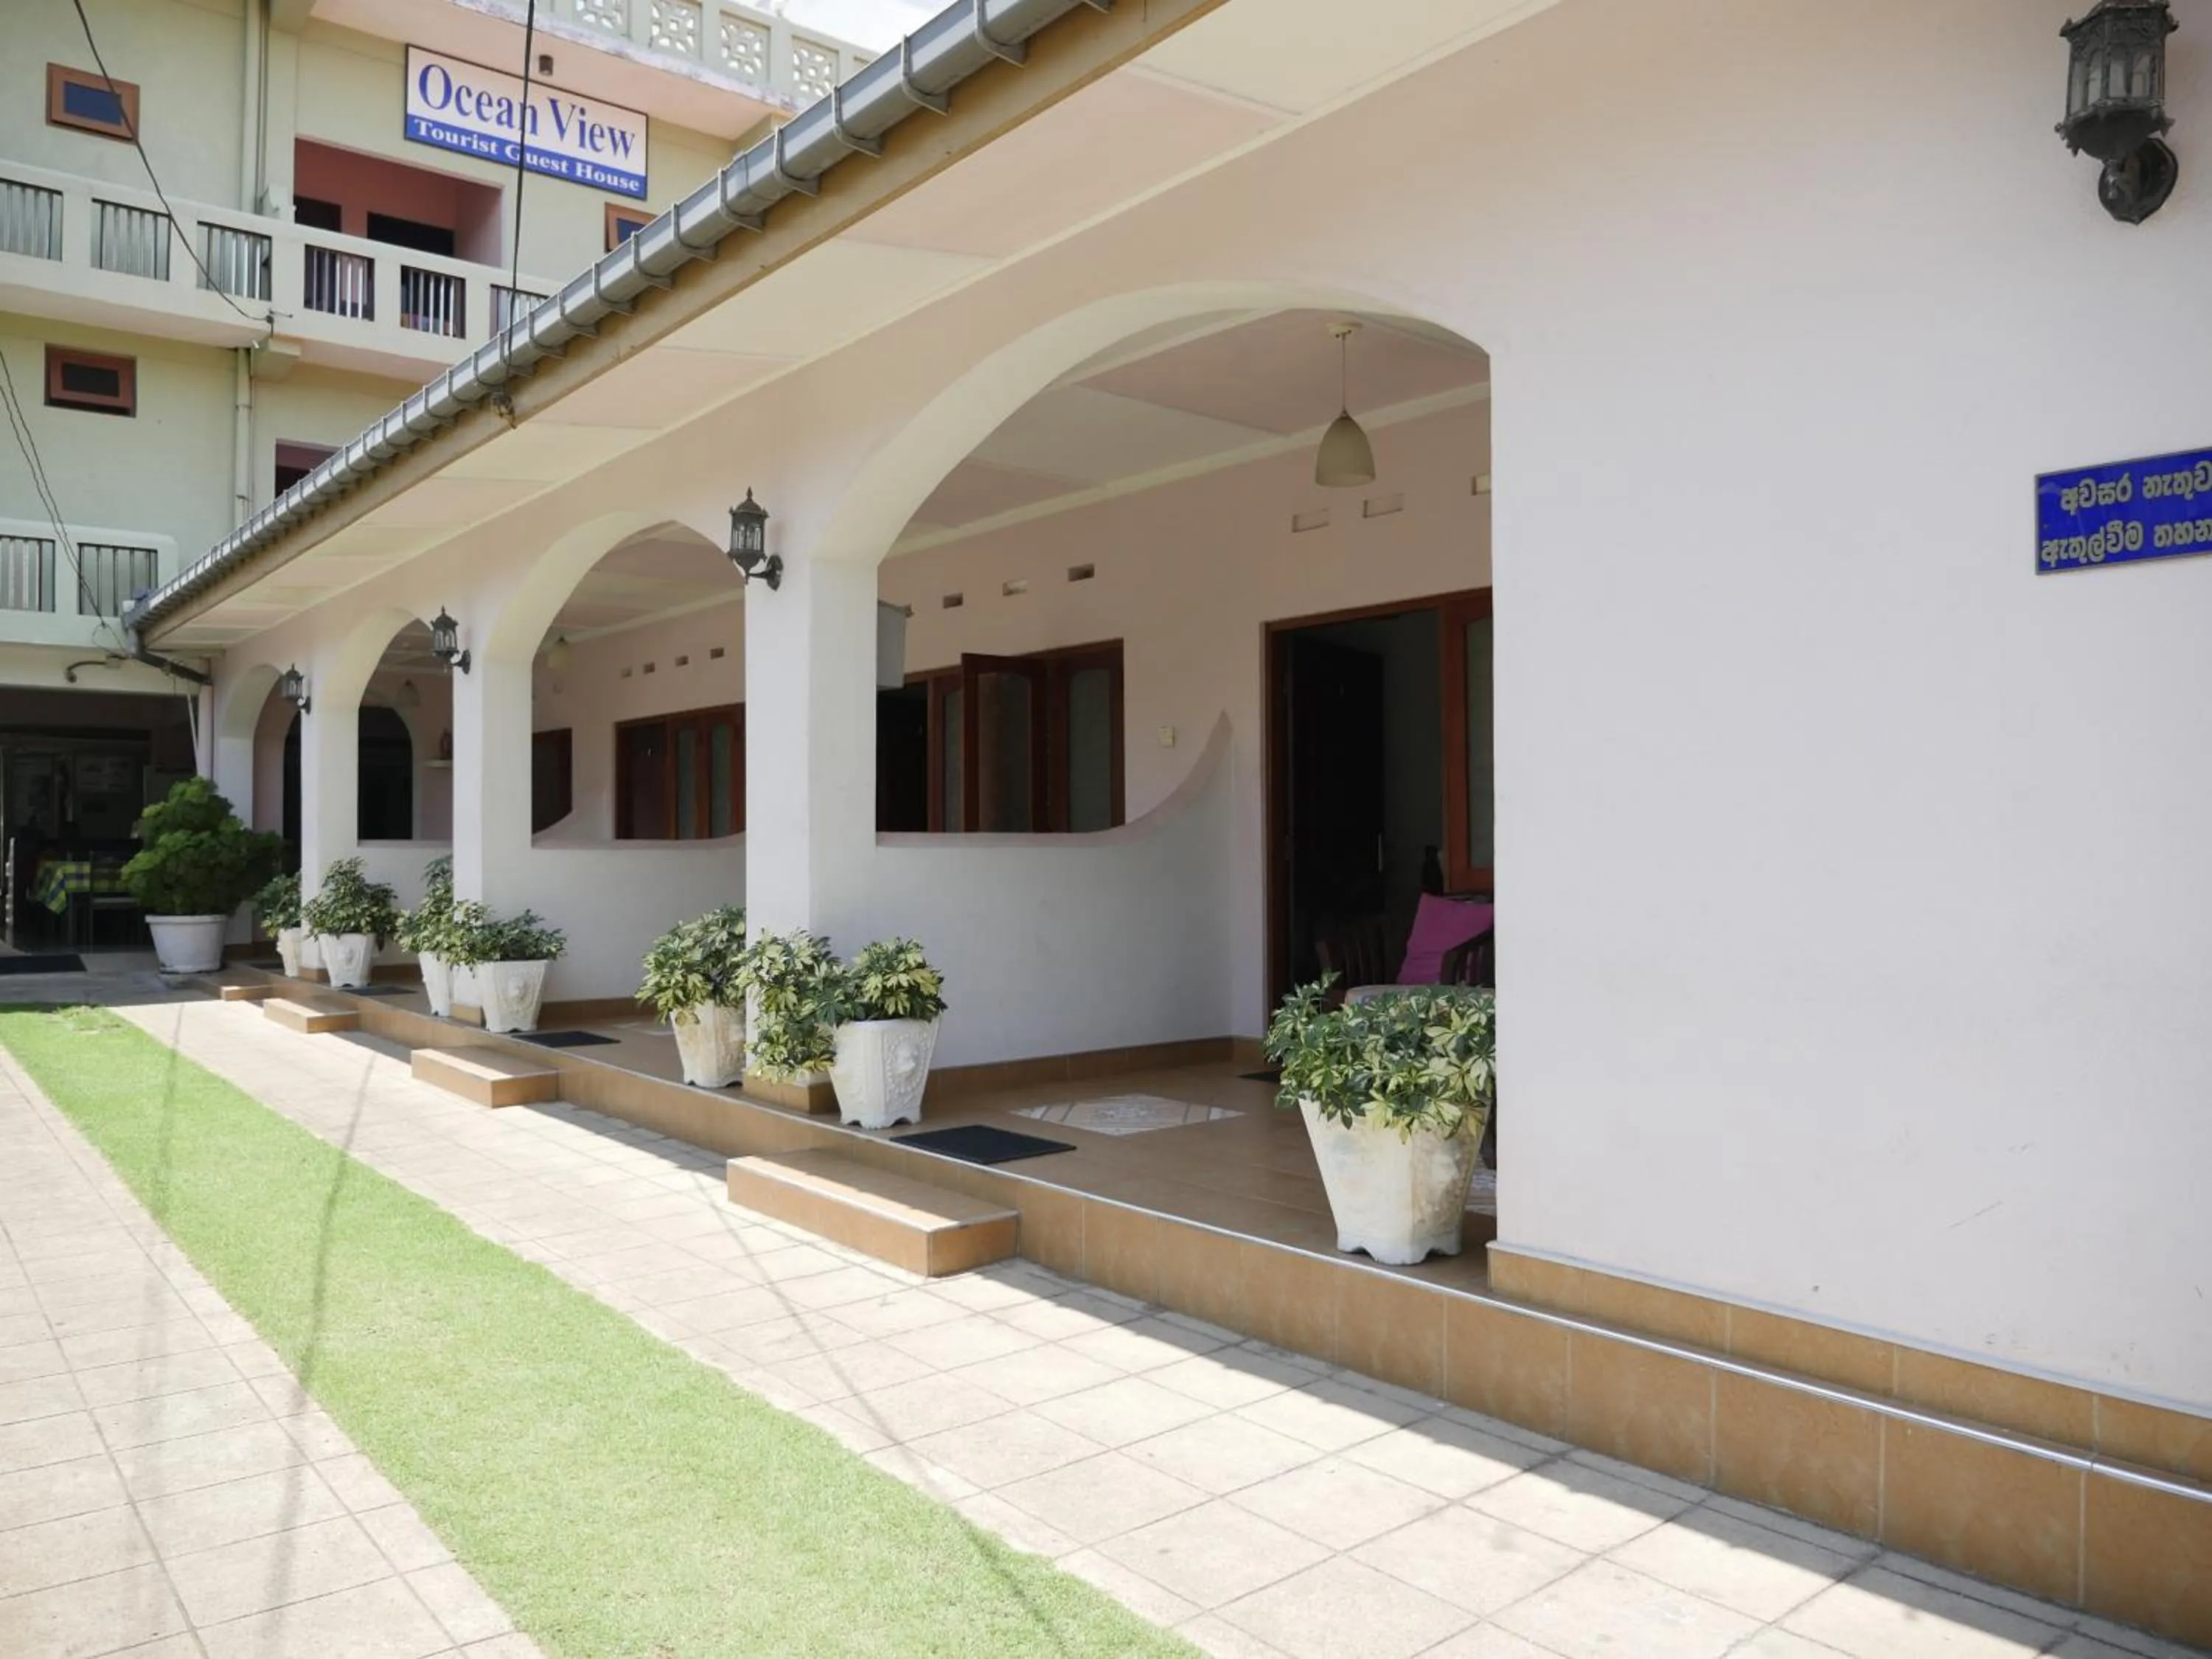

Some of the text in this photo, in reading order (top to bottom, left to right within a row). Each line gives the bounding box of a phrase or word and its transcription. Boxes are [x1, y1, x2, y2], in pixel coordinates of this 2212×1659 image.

[418, 63, 636, 160] Ocean View
[413, 117, 640, 192] Tourist Guest House
[2060, 472, 2133, 516] අවසර
